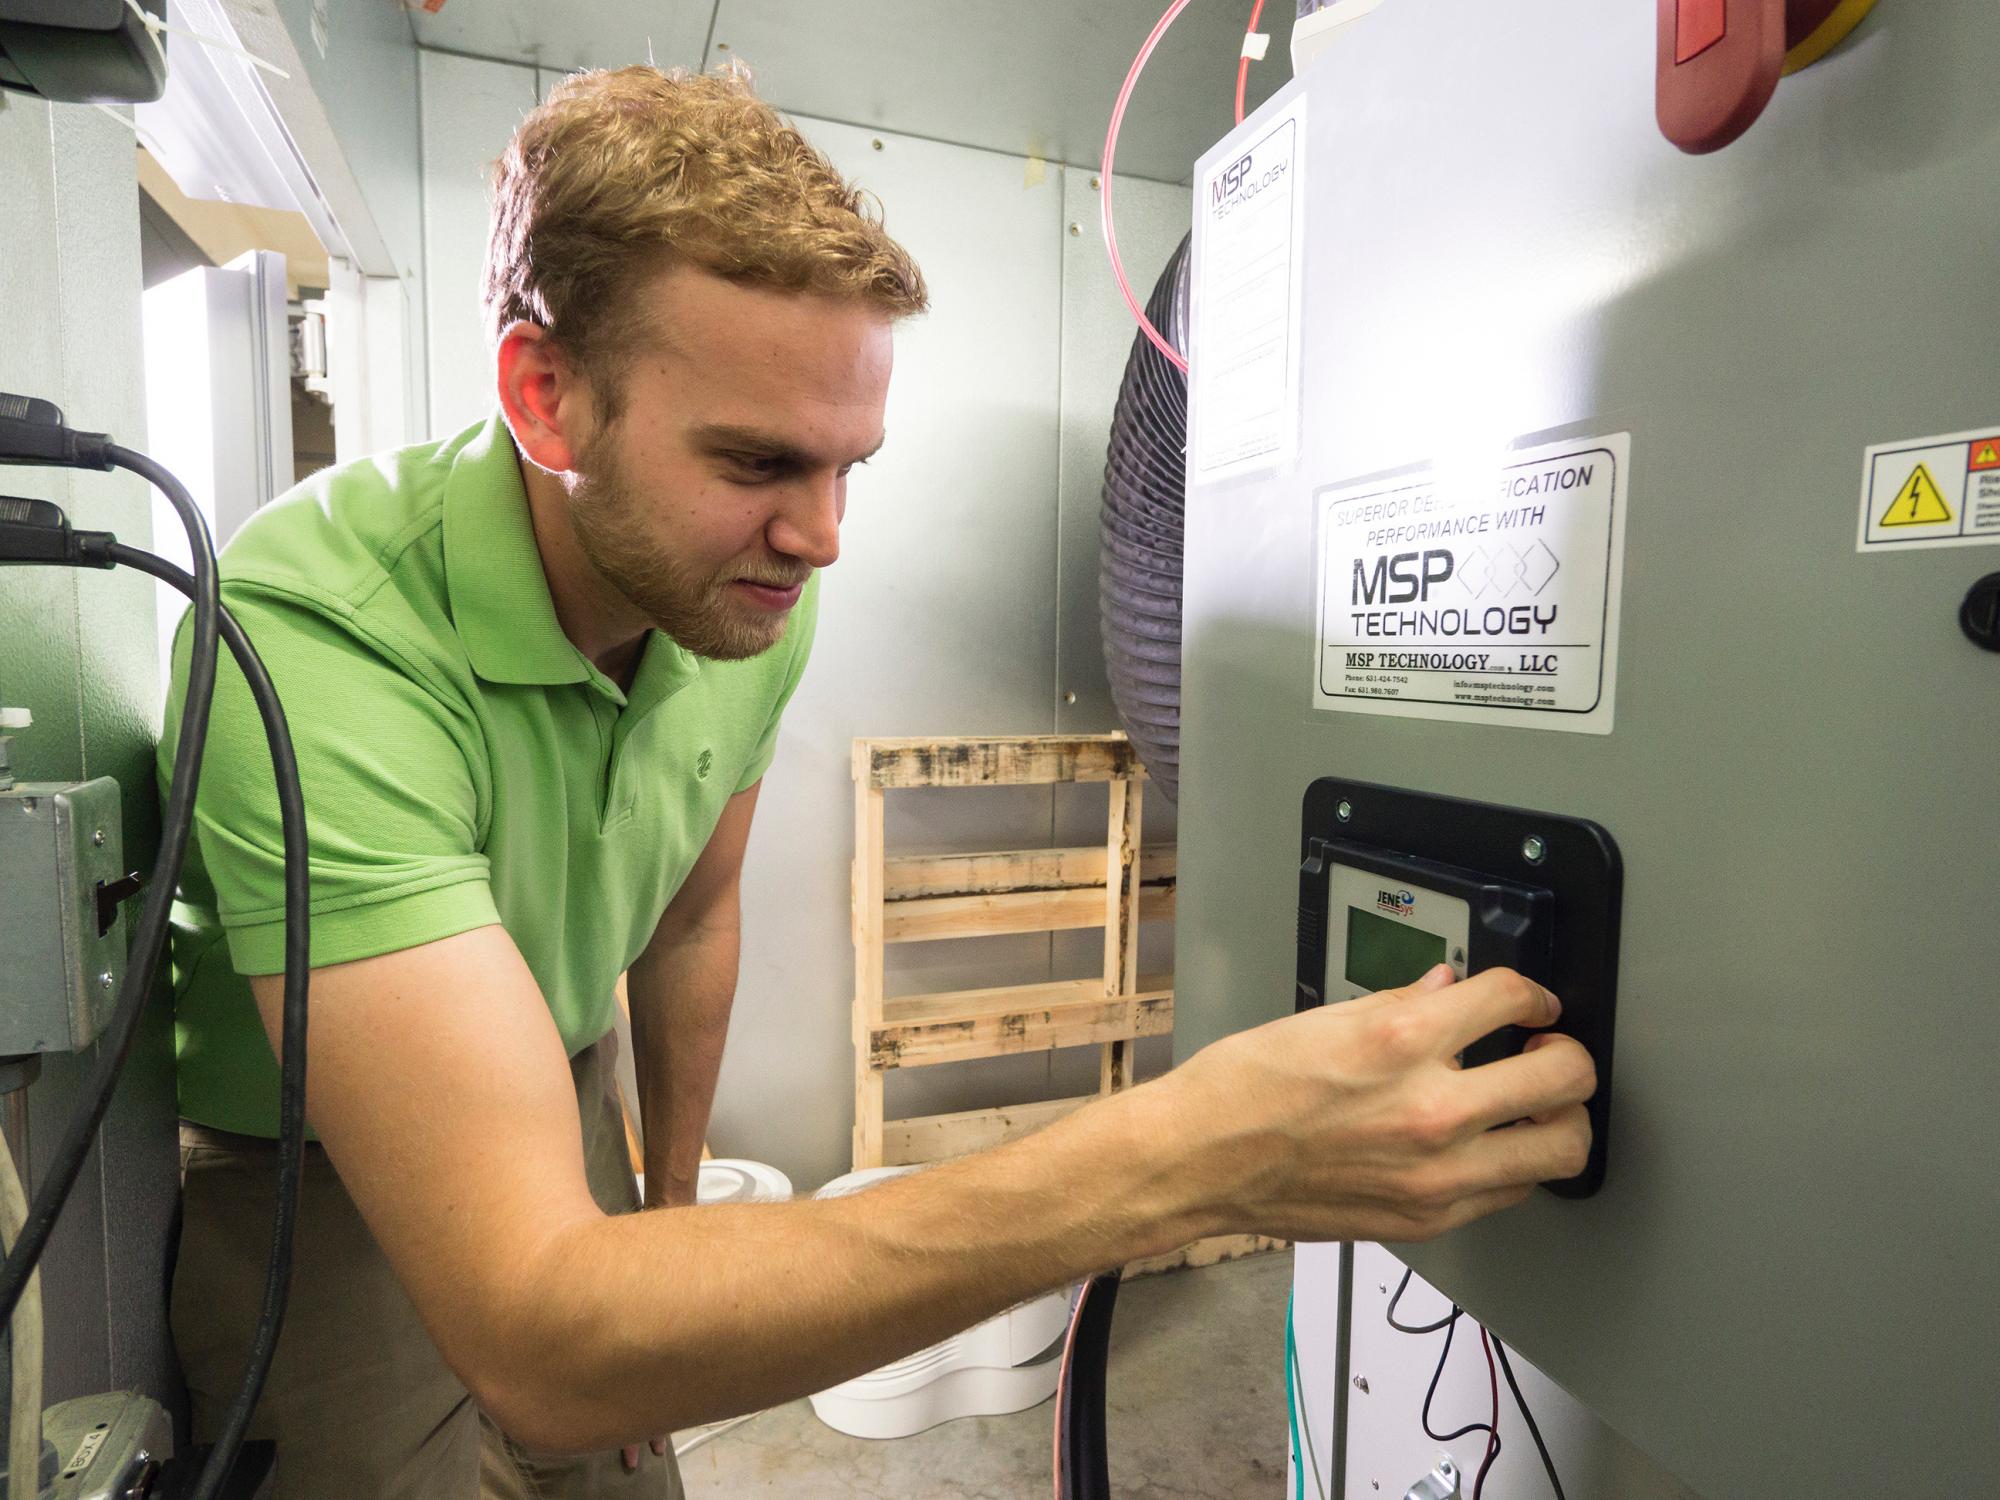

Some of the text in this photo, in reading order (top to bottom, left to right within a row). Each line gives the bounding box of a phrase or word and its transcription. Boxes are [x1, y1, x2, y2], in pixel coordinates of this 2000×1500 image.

[1212, 155, 1252, 207] MSP
[1212, 158, 1288, 220] TECHNOLOGY
[1336, 497, 1407, 527] SUPERIOR
[1366, 505, 1546, 547] PERFORMANCE WITH
[1351, 549, 1454, 606] MSP
[1351, 604, 1557, 637] TECHNOLOGY
[1345, 652, 1374, 668] MSP
[1519, 654, 1558, 673] LLC
[1345, 674, 1365, 682] Phone:
[71, 1443, 95, 1467] BOX
